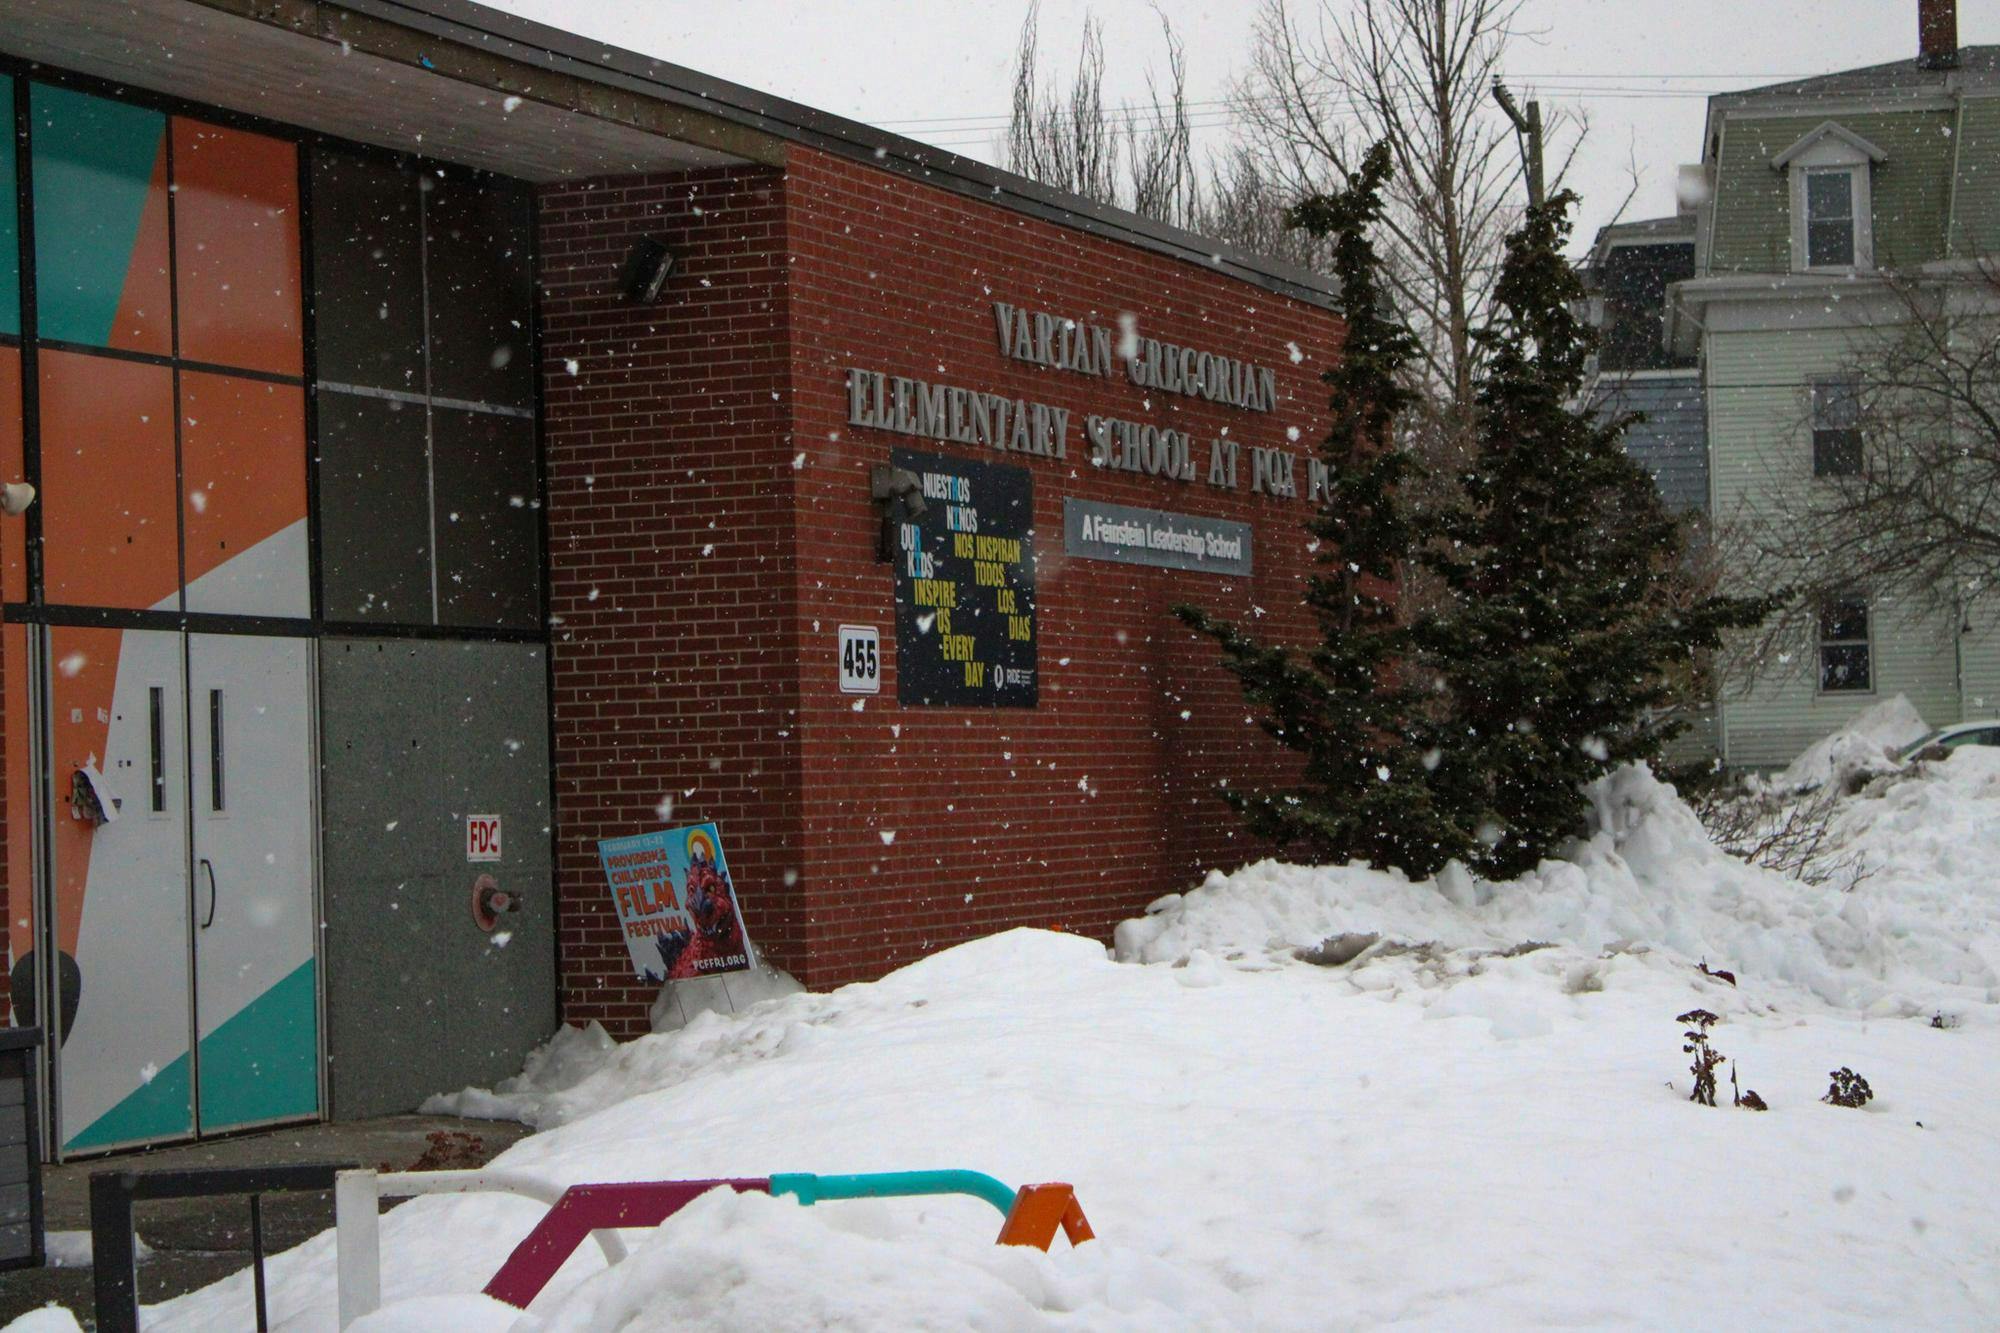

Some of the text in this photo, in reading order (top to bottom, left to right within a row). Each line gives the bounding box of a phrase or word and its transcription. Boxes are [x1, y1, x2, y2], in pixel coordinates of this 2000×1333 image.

[993, 302, 1276, 411] VARTAN GREGORIAN
[847, 368, 1069, 459] ELEMENTARY
[1087, 415, 1196, 482] SCHOOL
[1208, 439, 1240, 487] AT
[1252, 447, 1297, 498] FOX
[923, 472, 970, 503] NUESTROS
[901, 523, 921, 552] OUR
[954, 533, 974, 559] NOS
[1082, 514, 1242, 561] A Feinstein Leadership School
[907, 551, 934, 579] KIDS
[974, 561, 1005, 587] TODOS
[914, 579, 956, 607] INSPIRE
[997, 589, 1015, 614] LOS
[936, 608, 951, 634] US
[844, 639, 876, 679] 455
[943, 635, 976, 661] EVERY
[965, 662, 984, 688] DAY
[471, 821, 497, 853] FDC
[616, 880, 679, 917] FILM
[625, 915, 687, 938] FESTIVAL
